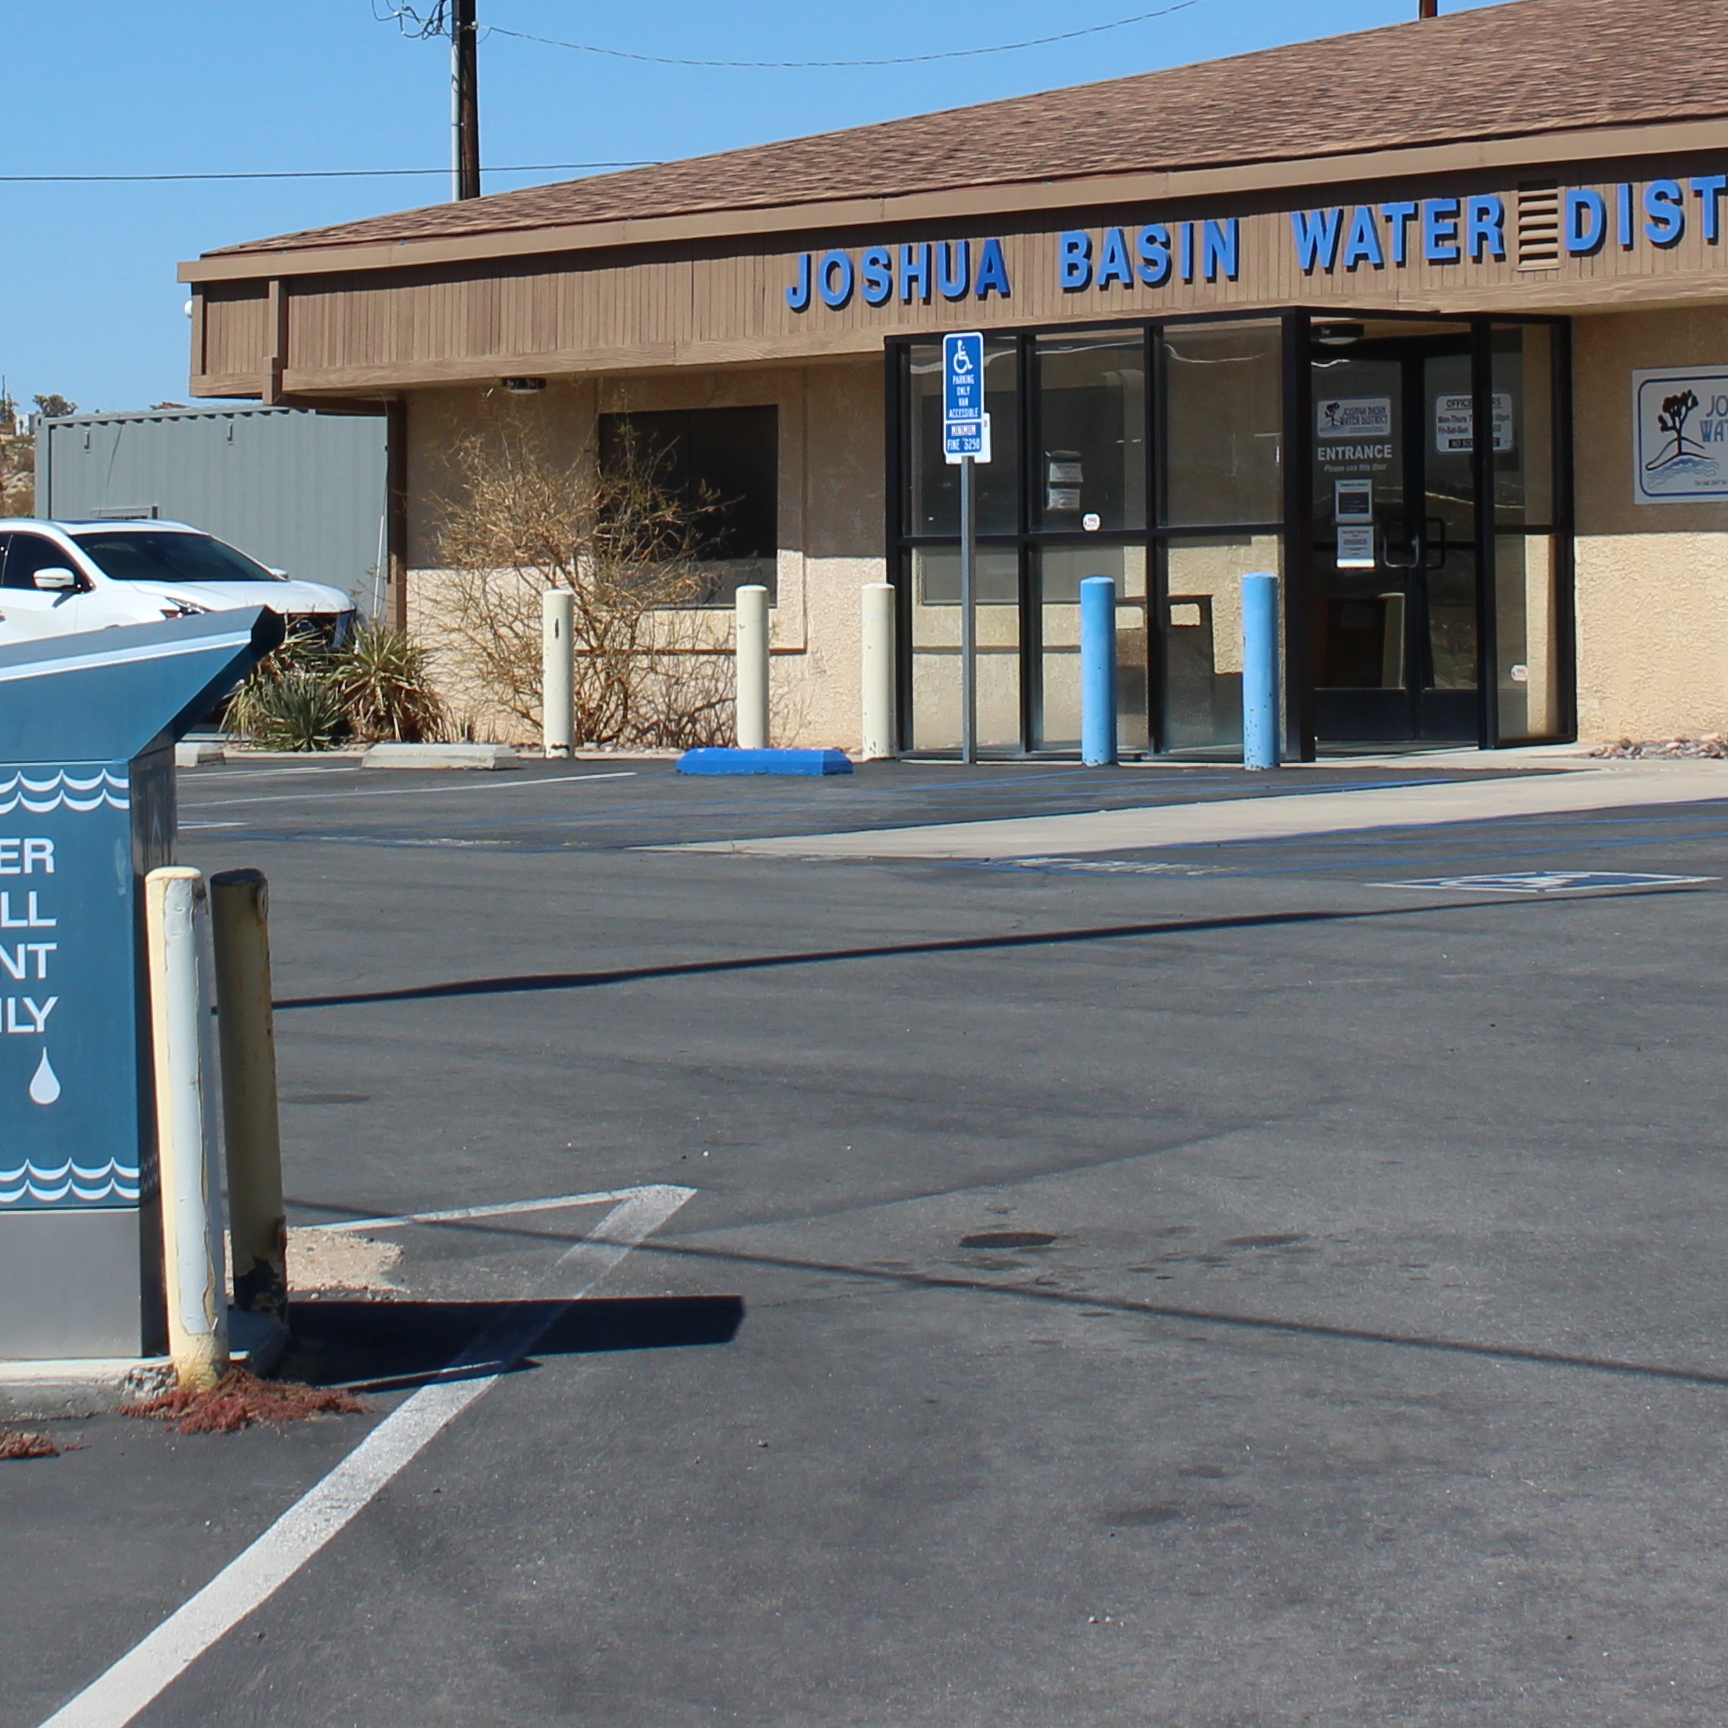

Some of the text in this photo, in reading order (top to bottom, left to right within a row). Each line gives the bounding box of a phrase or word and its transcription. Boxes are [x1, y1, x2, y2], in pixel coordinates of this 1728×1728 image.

[785, 238, 1010, 310] JOSHUA
[1060, 218, 1239, 290] BASIN
[1291, 195, 1506, 271] WATER
[952, 374, 975, 385] PARKING
[957, 386, 970, 396] ONLY
[958, 397, 969, 407] VAN
[949, 407, 979, 418] ACCESSIBLE
[947, 439, 960, 451] FINE
[1317, 444, 1392, 461] ENTRANCE
[1323, 464, 1345, 473] Please
[1359, 463, 1371, 471] this
[1372, 462, 1387, 471] door
